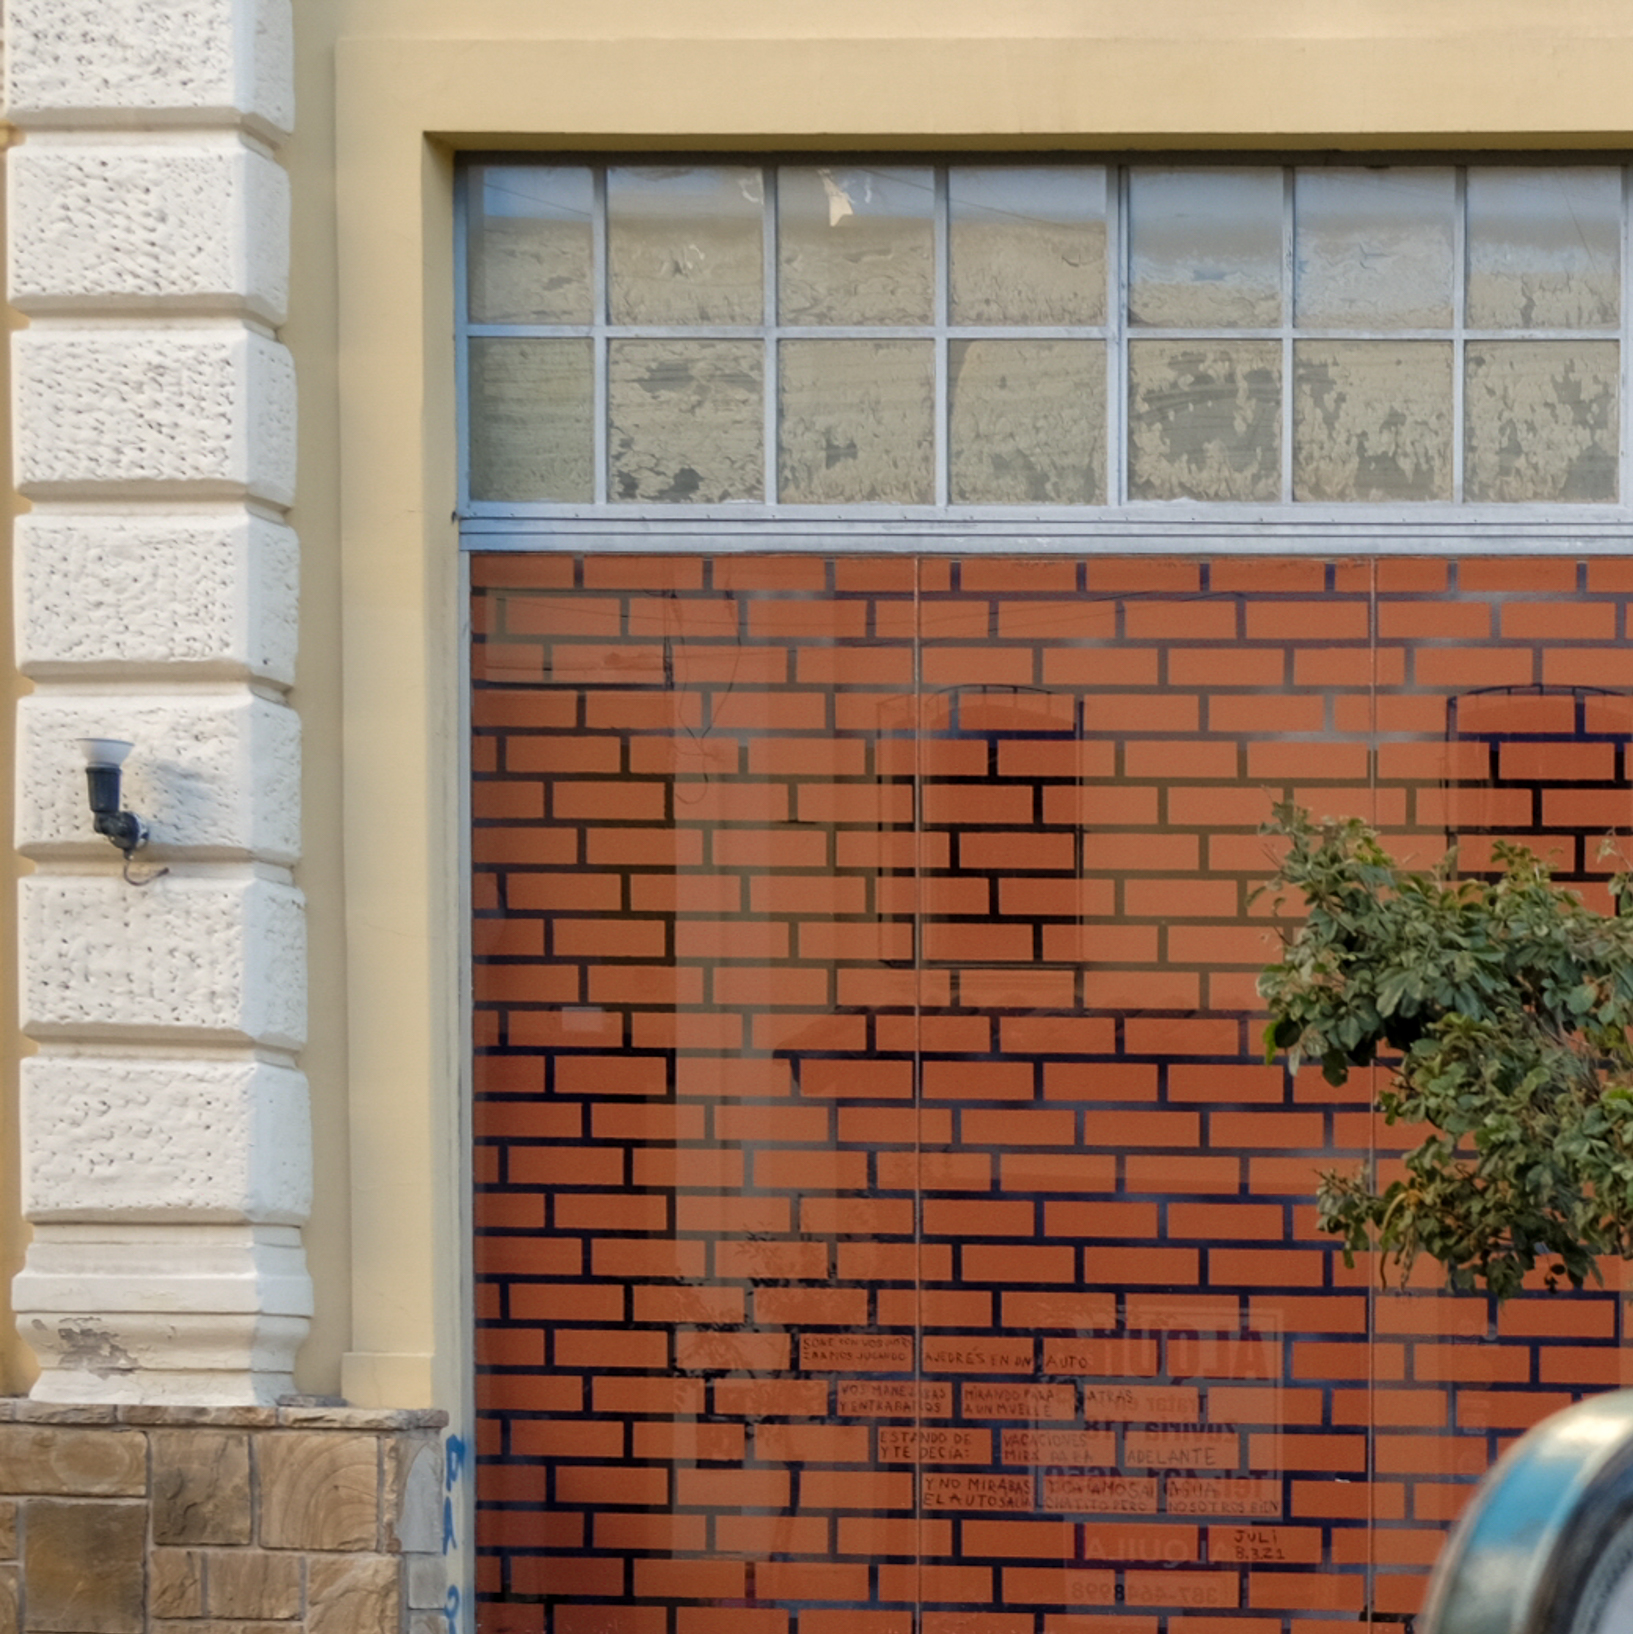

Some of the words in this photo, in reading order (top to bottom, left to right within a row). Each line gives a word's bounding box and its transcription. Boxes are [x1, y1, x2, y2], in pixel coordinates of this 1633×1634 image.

[1046, 1356, 1088, 1369] AUTO
[954, 1433, 971, 1446] DE
[894, 1447, 911, 1459] TE
[1127, 1448, 1216, 1465] ADELANTE
[939, 1478, 961, 1489] NO
